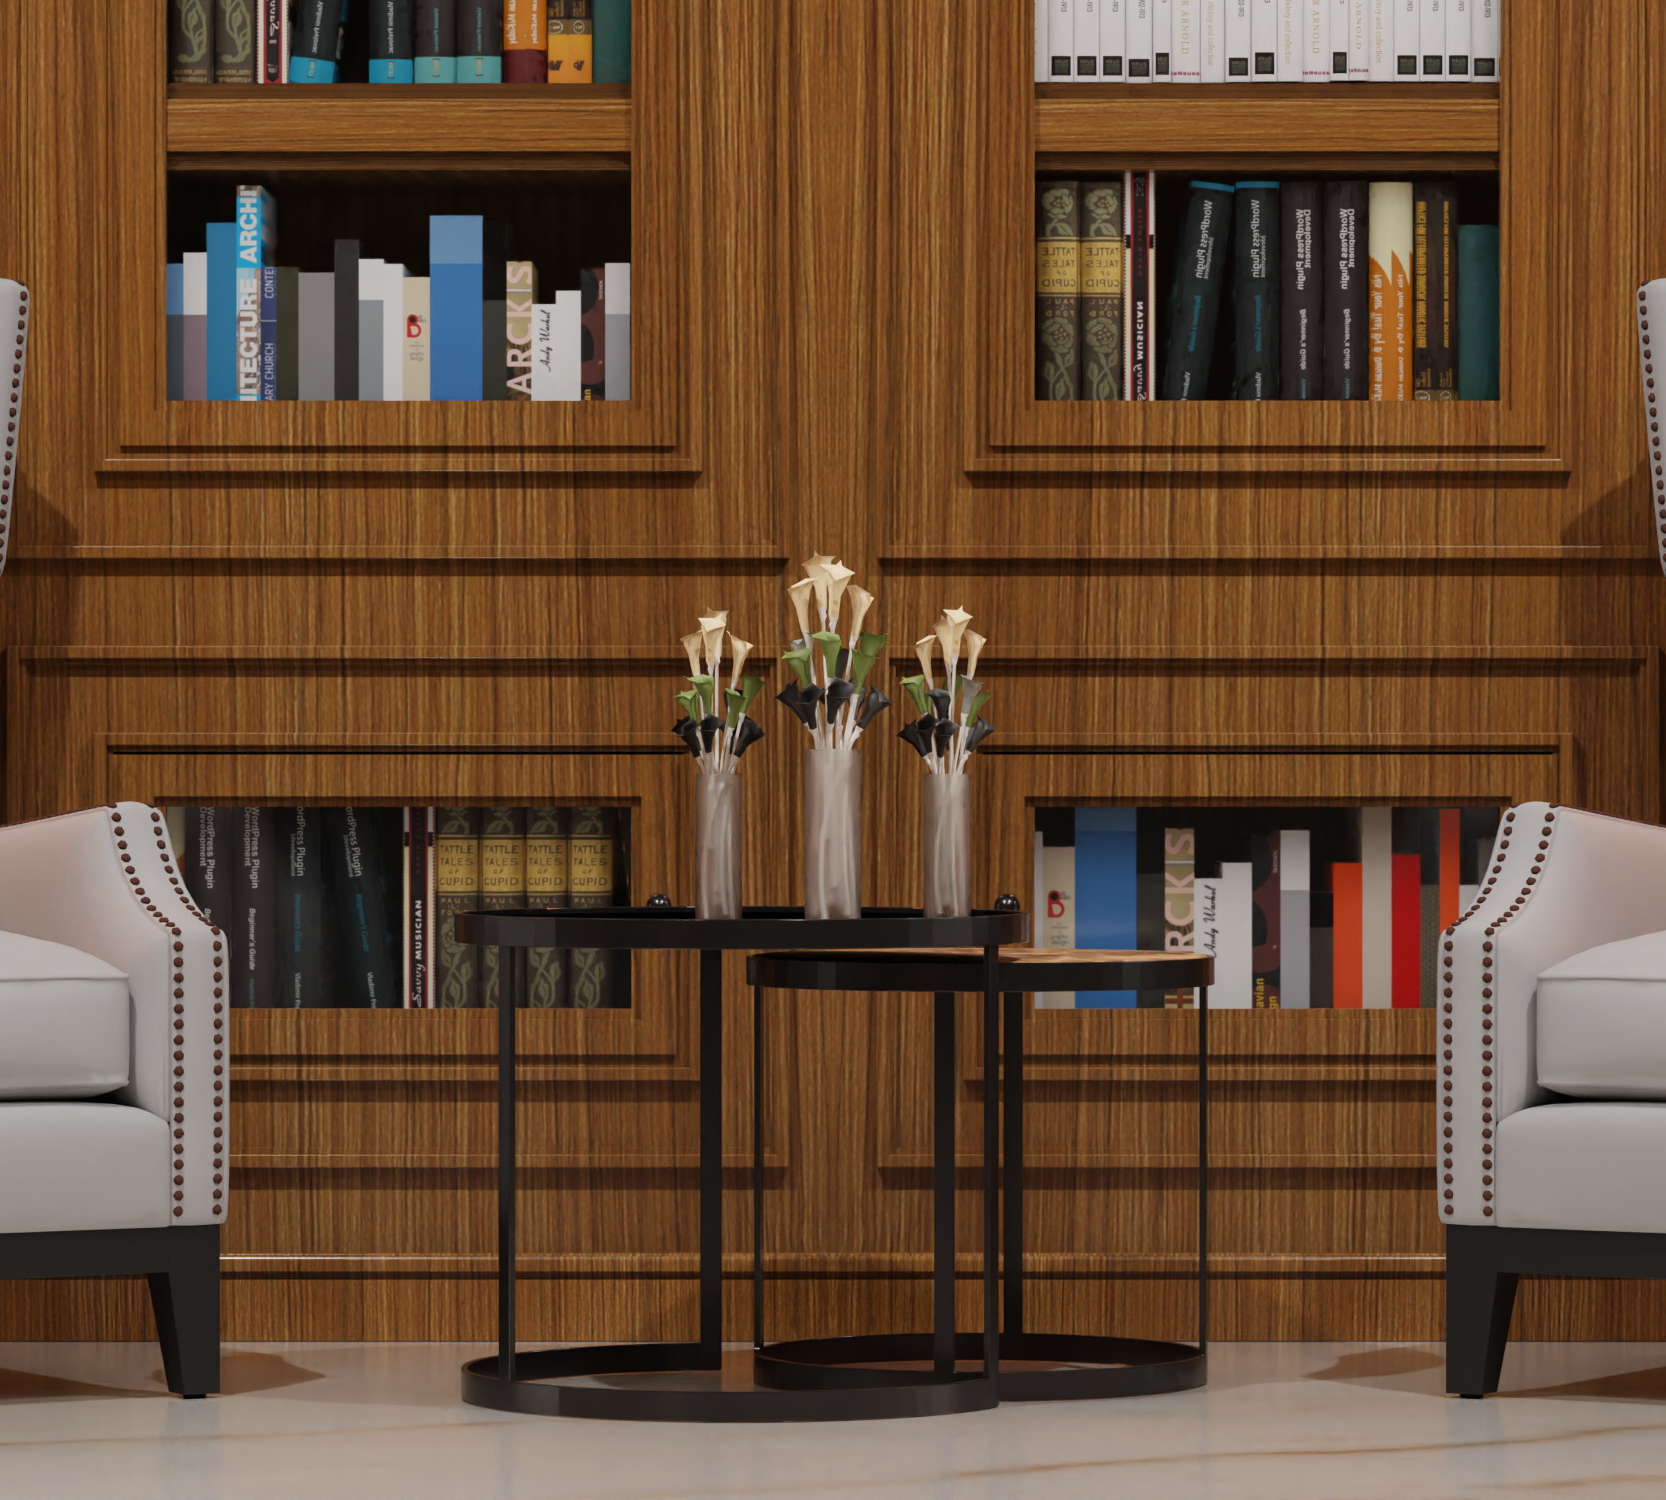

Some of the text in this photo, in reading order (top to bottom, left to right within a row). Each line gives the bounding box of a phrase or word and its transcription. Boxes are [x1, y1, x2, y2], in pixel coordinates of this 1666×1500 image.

[540, 310, 552, 372] Andy Warhol
[263, 342, 275, 382] CHURCH
[243, 805, 253, 868] Development
[573, 844, 610, 855] TATTLE
[573, 876, 608, 887] CUPID
[574, 857, 608, 868] TALES
[1208, 886, 1218, 959] Andy Warhol
